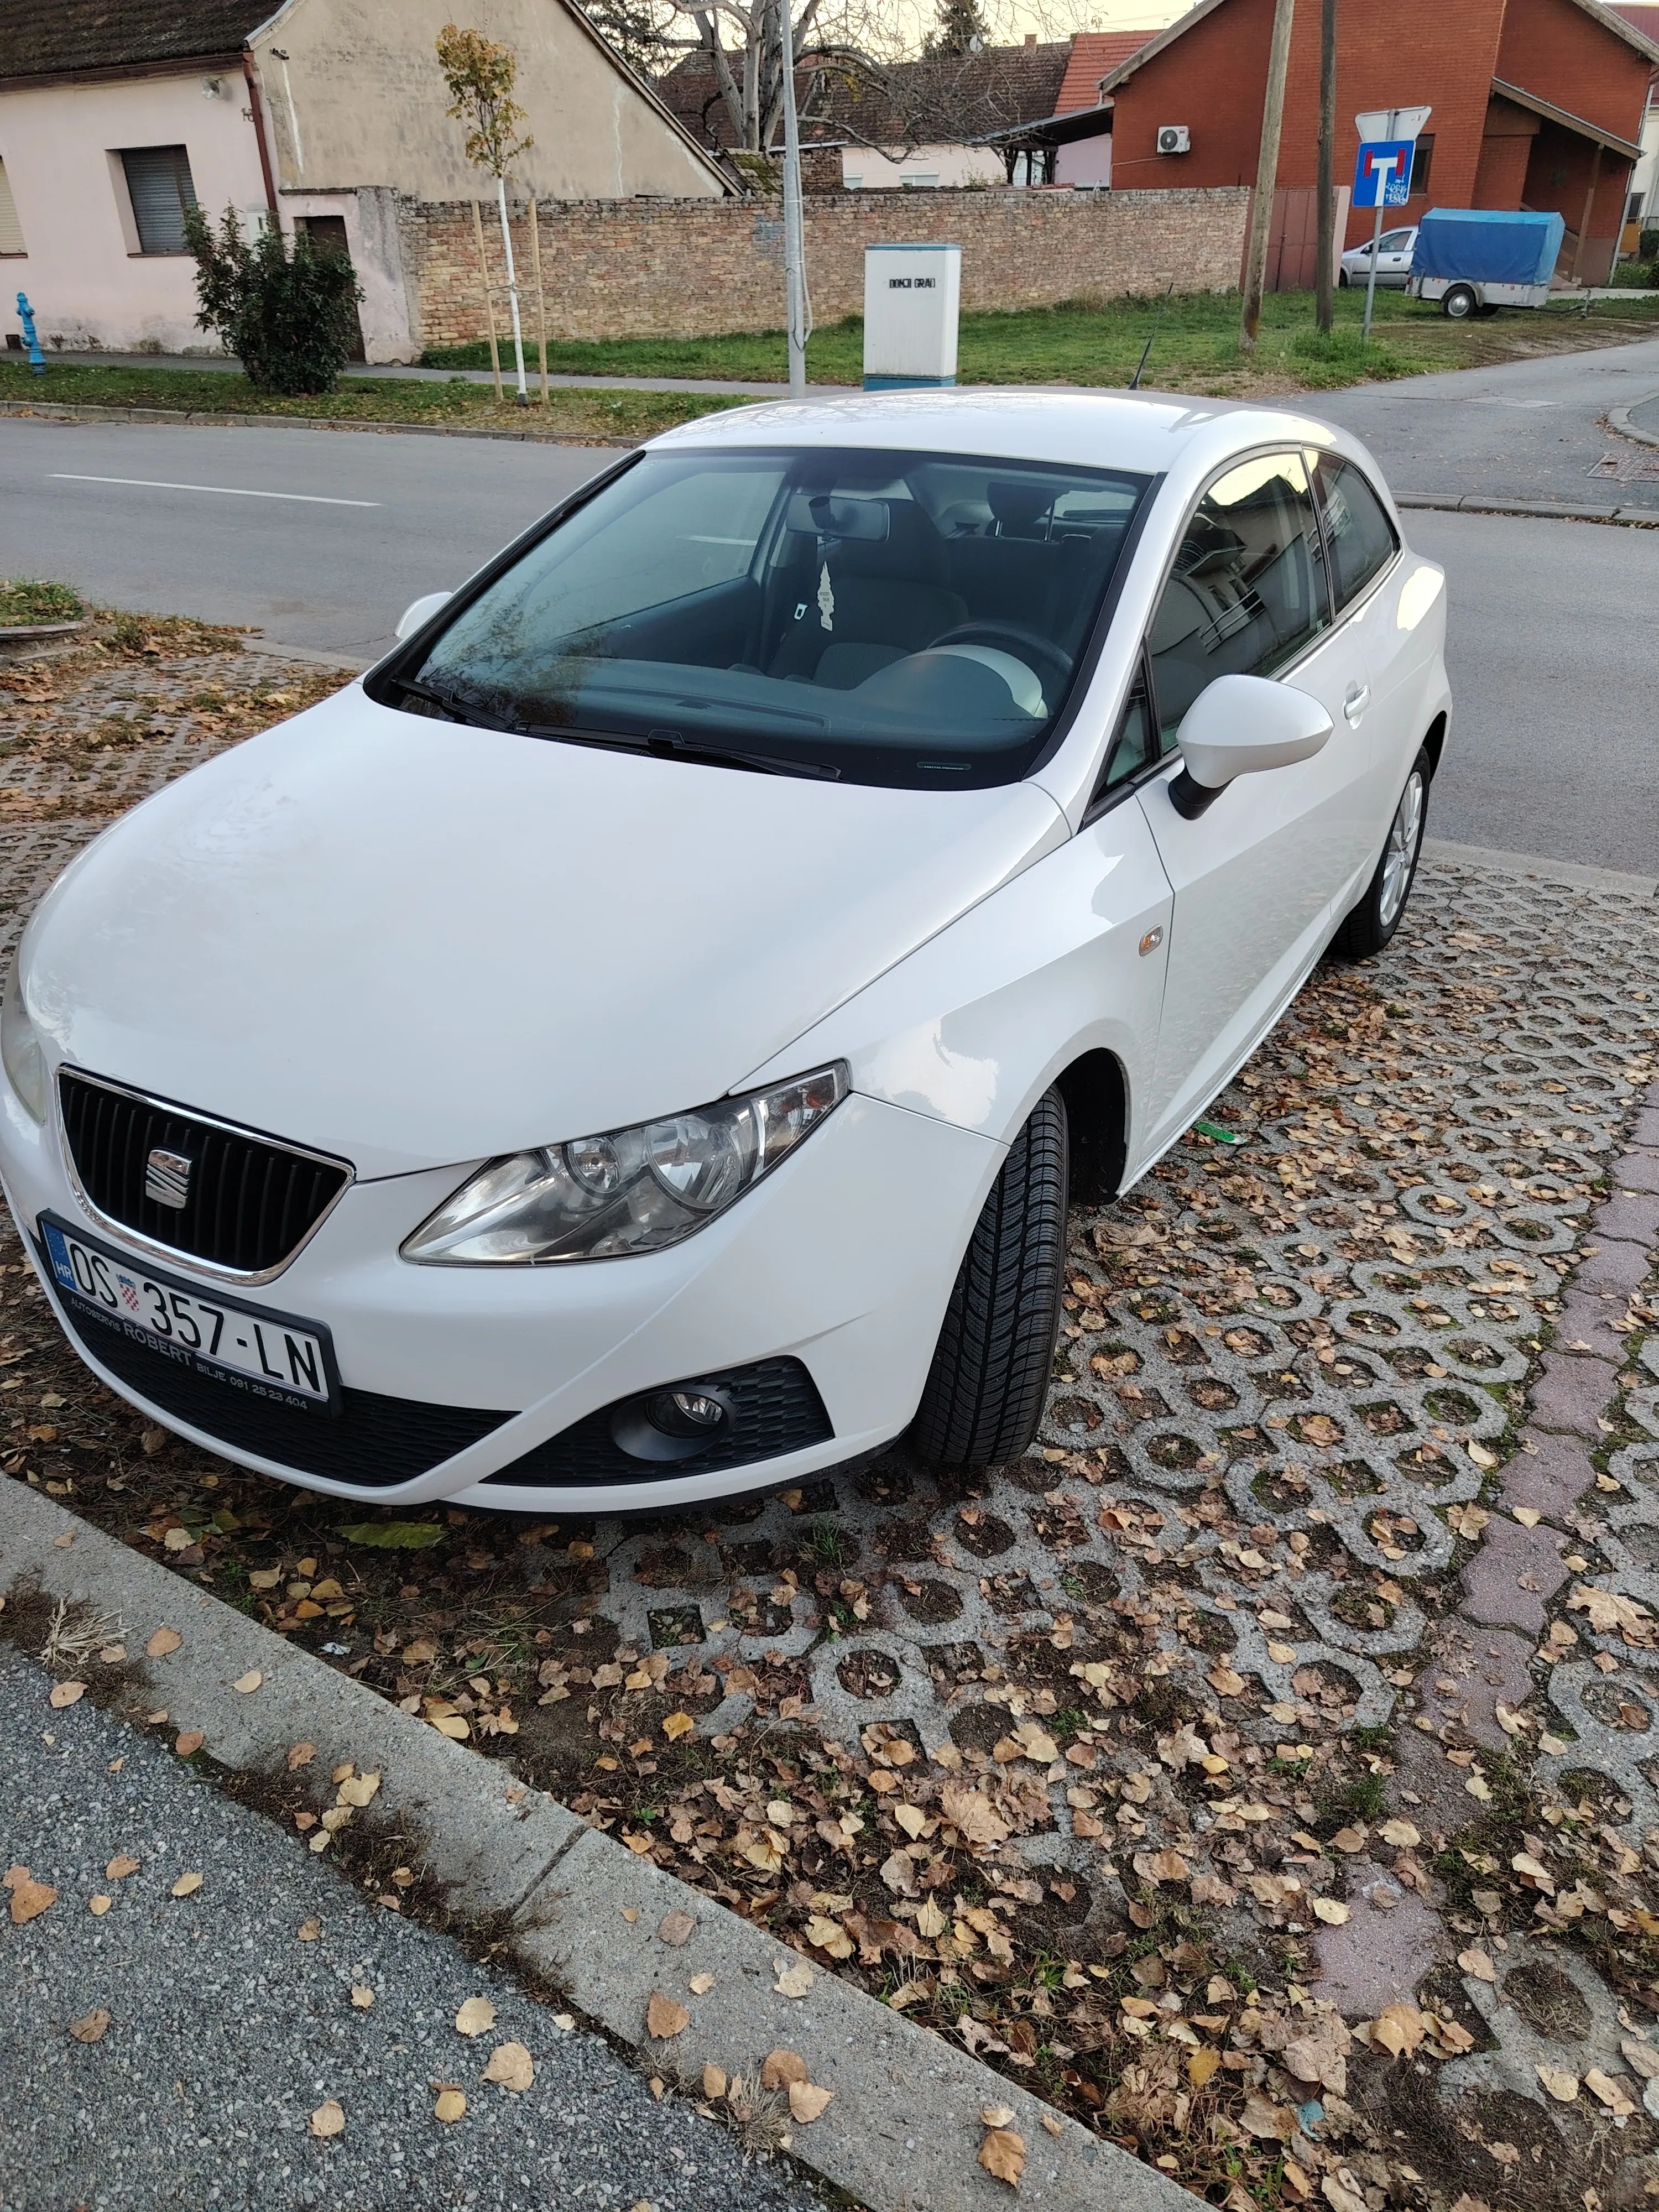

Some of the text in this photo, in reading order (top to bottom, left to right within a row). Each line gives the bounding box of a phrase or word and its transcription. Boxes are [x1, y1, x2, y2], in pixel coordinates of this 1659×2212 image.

[914, 278, 935, 288] GRAD
[55, 1260, 75, 1281] HR
[70, 1243, 321, 1393] OS 357-LN
[71, 1297, 121, 1332] AUTOSERVIS
[123, 1322, 191, 1366] ROBERT
[196, 1363, 226, 1381] BILJE
[230, 1376, 248, 1390] 091
[285, 1396, 308, 1410] 404
